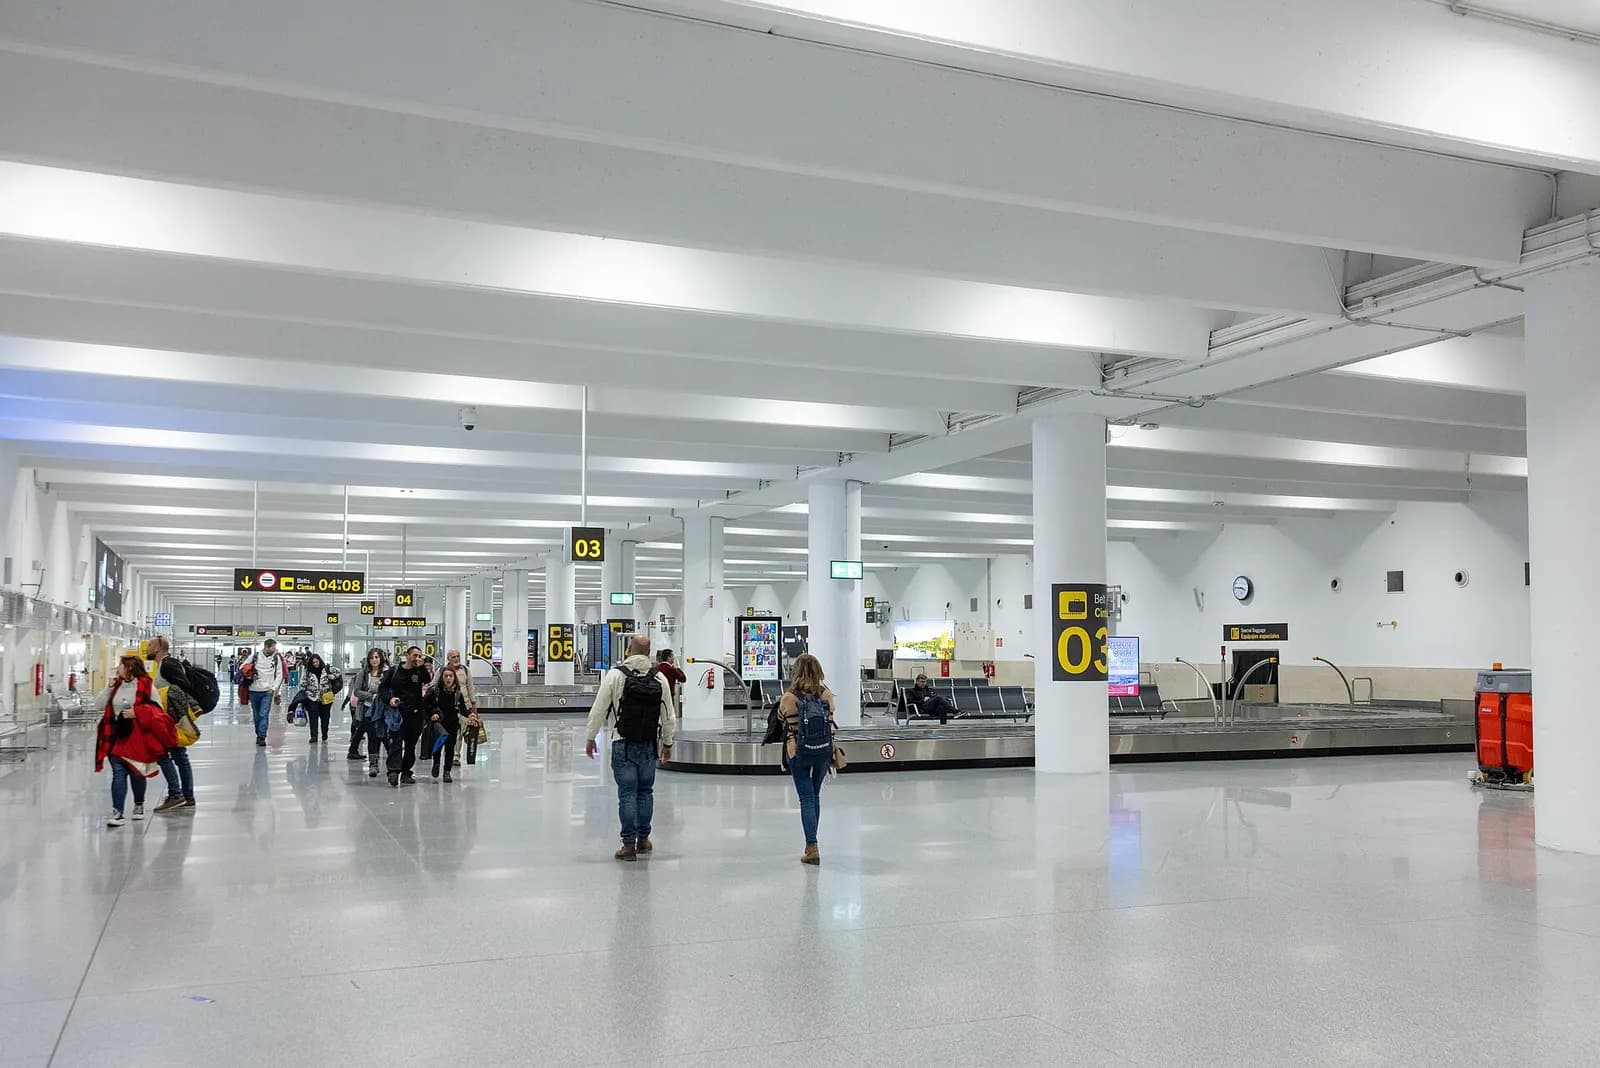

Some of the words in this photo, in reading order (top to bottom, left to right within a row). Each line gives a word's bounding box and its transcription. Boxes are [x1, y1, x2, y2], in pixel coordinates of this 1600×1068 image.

[575, 539, 601, 558] 03
[318, 578, 338, 591] 04
[342, 579, 361, 592] 08
[396, 594, 412, 605] 04
[361, 605, 374, 614] 05
[473, 642, 492, 658] 06
[549, 640, 573, 660] 05
[1057, 626, 1107, 675] 03
